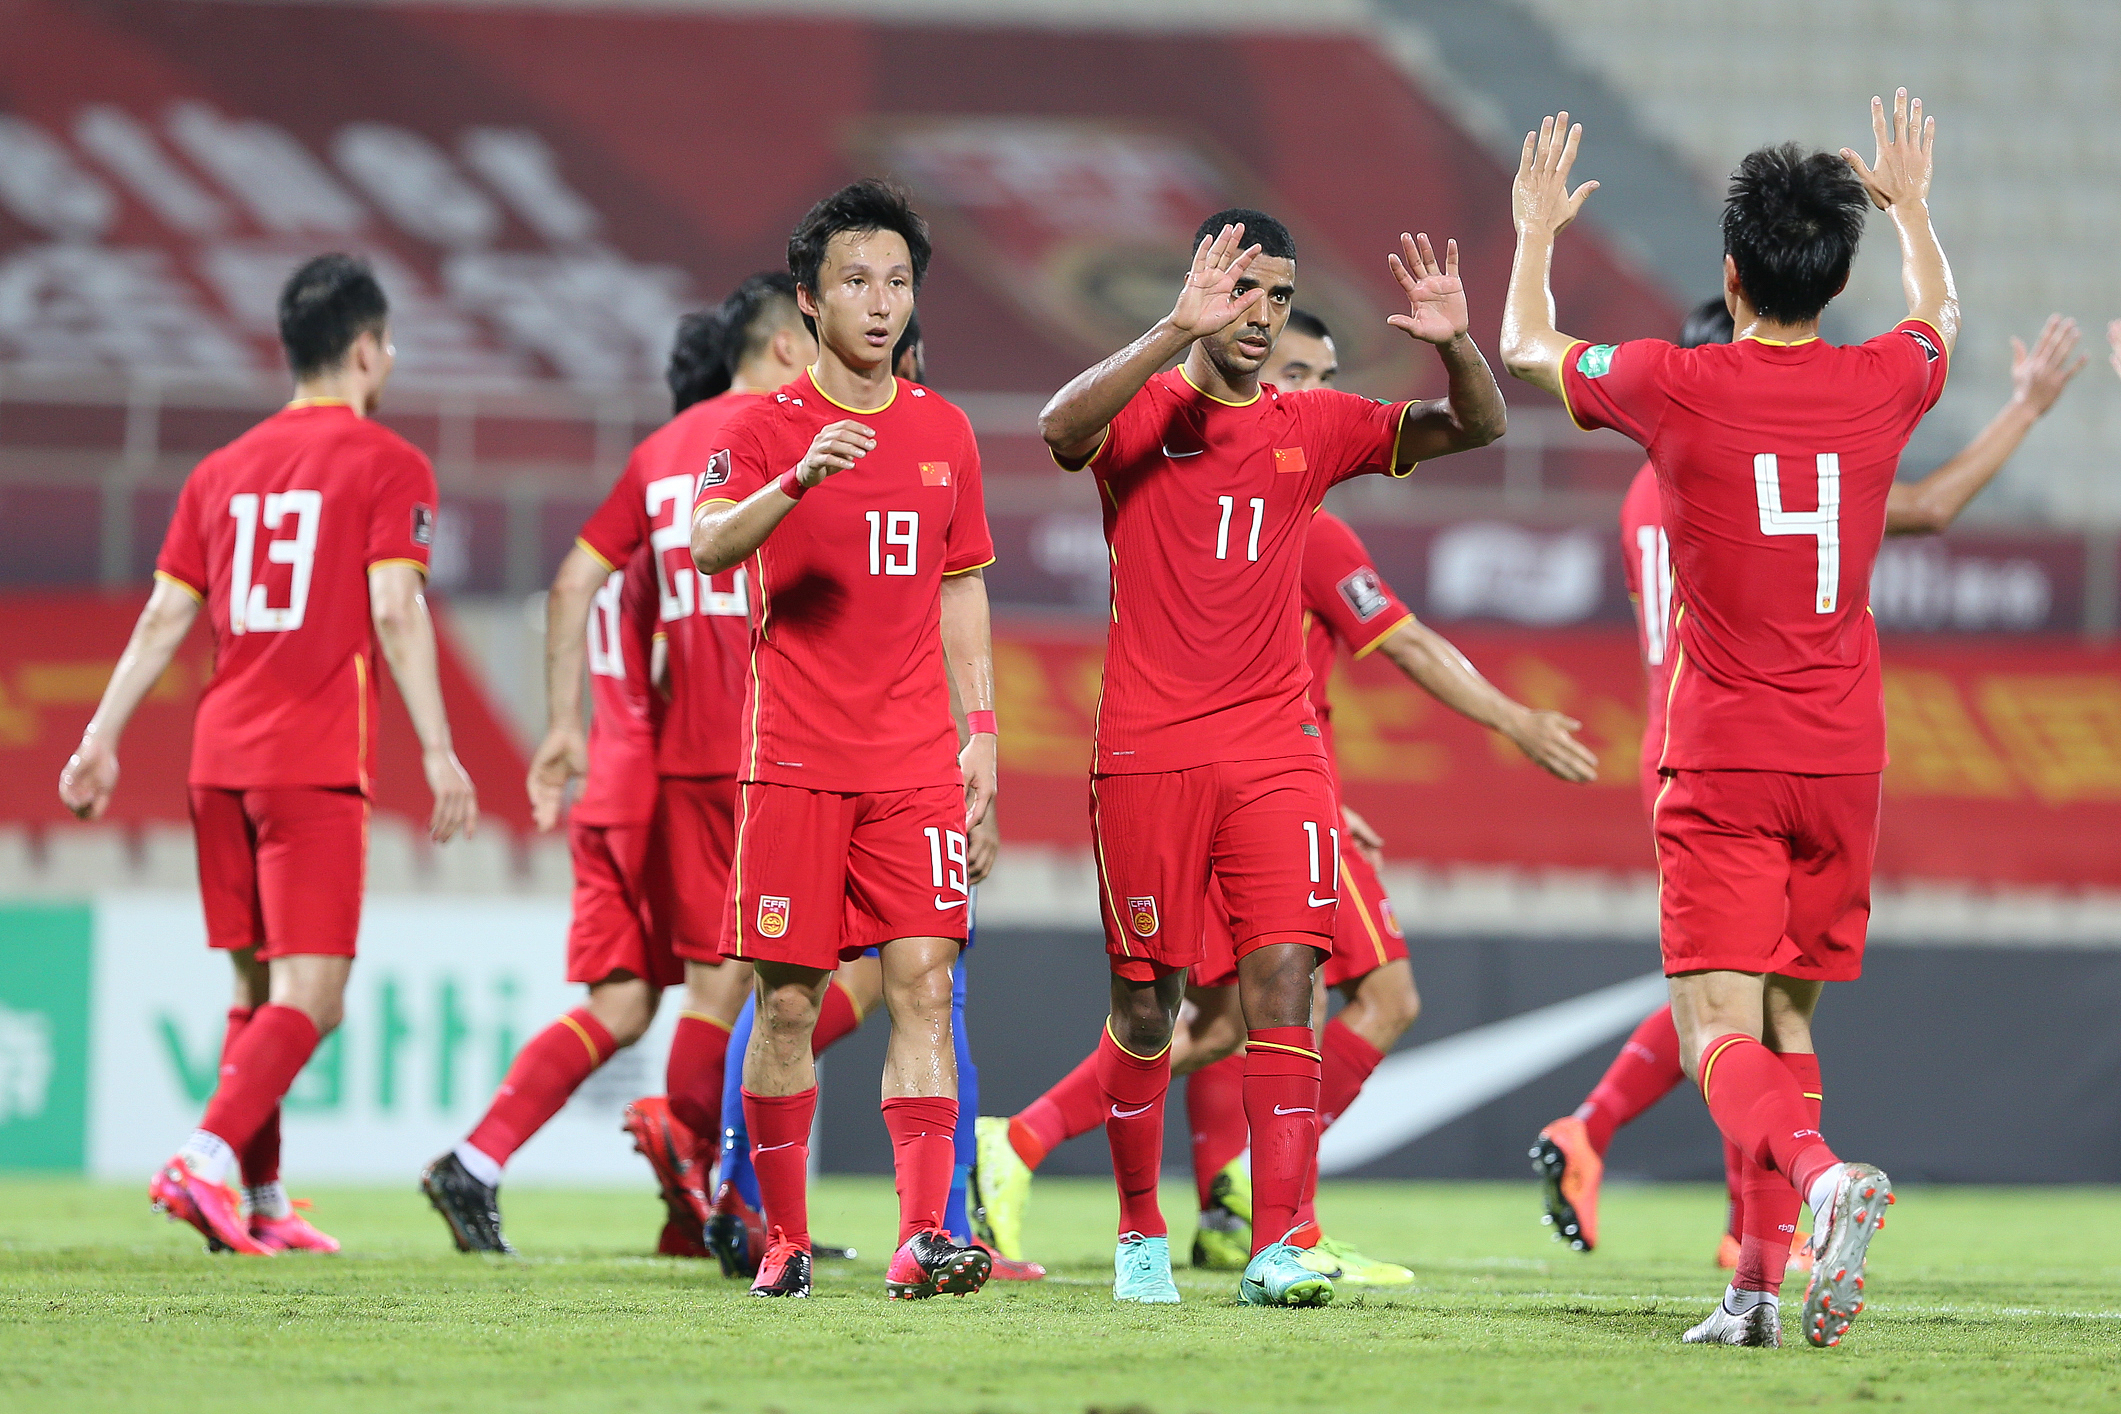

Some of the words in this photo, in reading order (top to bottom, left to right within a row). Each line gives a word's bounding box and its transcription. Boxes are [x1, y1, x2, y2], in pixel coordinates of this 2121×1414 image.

[229, 489, 323, 636] 13
[865, 510, 919, 576] 19
[1215, 495, 1265, 562] 11
[1753, 452, 1840, 614] 4
[923, 826, 968, 896] 19
[1302, 820, 1338, 891] 11
[763, 899, 787, 909] CFA
[1130, 900, 1152, 908] CFA
